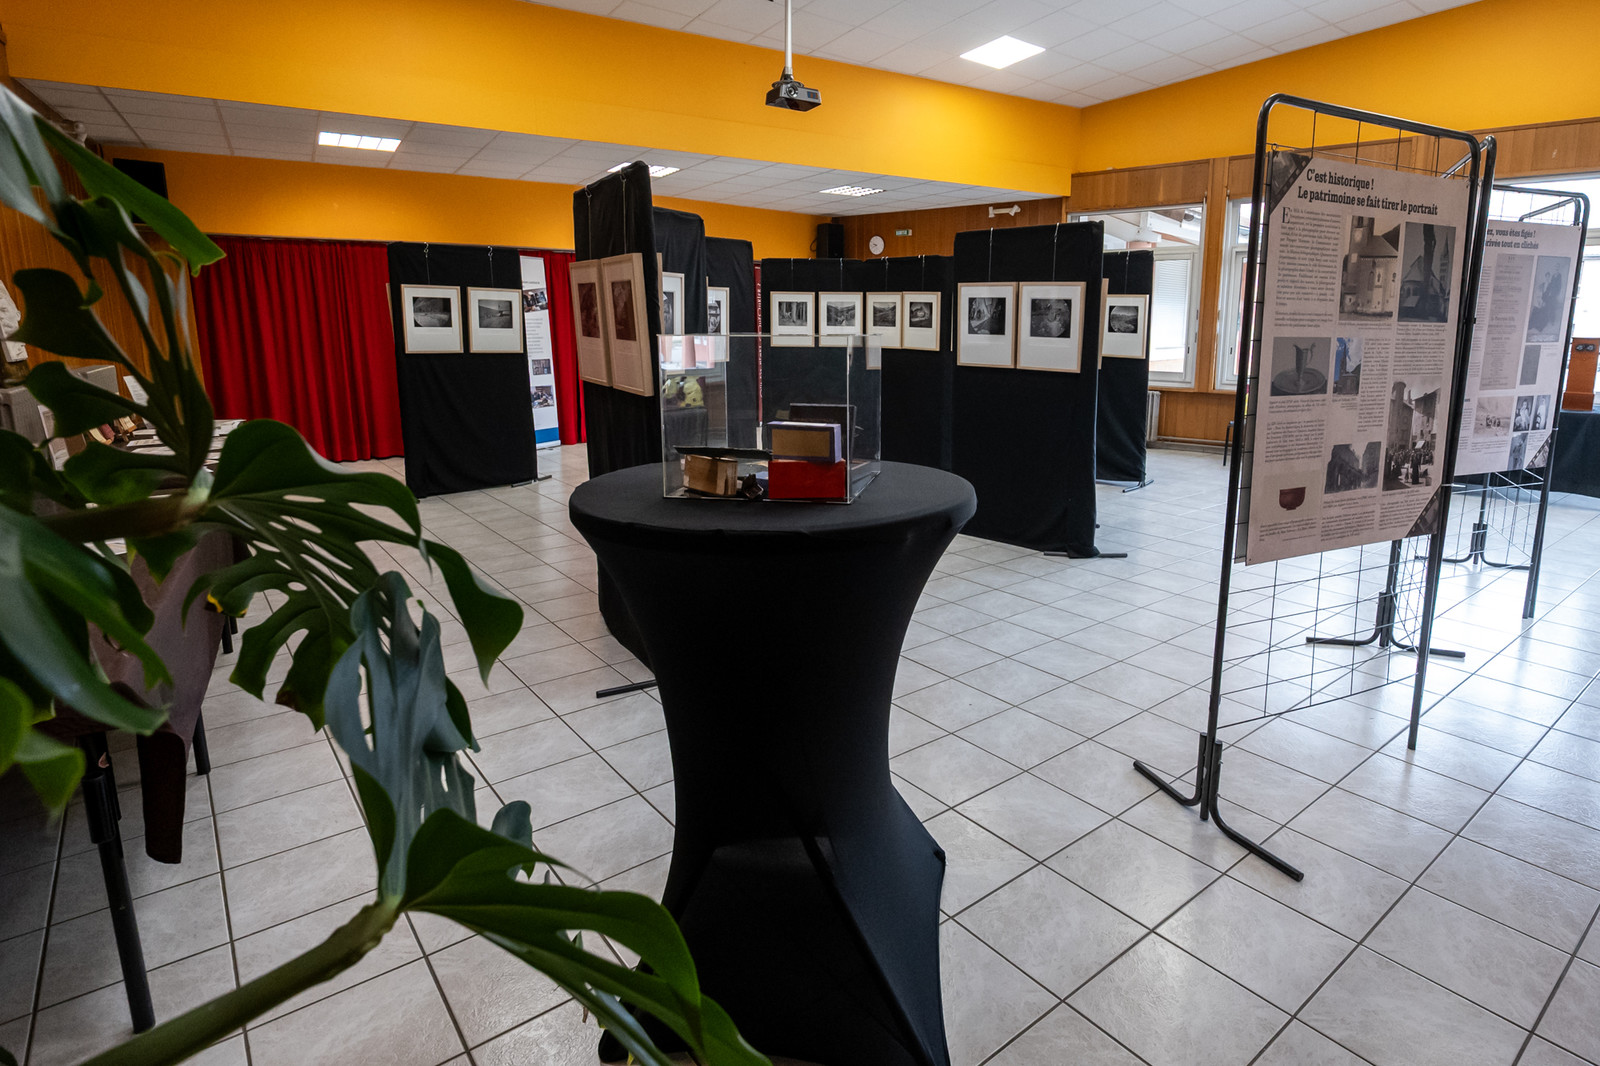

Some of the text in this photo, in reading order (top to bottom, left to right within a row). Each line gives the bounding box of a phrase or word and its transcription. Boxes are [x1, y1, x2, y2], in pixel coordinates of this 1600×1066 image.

[1306, 168, 1375, 191] C’est historique !
[1298, 186, 1438, 216] Le patrimoine se fait tirer le portrait
[1495, 229, 1508, 237] vous
[1509, 228, 1520, 237] êtes
[1521, 229, 1533, 239] figés
[1485, 239, 1501, 247] rivée
[1501, 240, 1513, 248] tout
[1521, 240, 1539, 249] clichés
